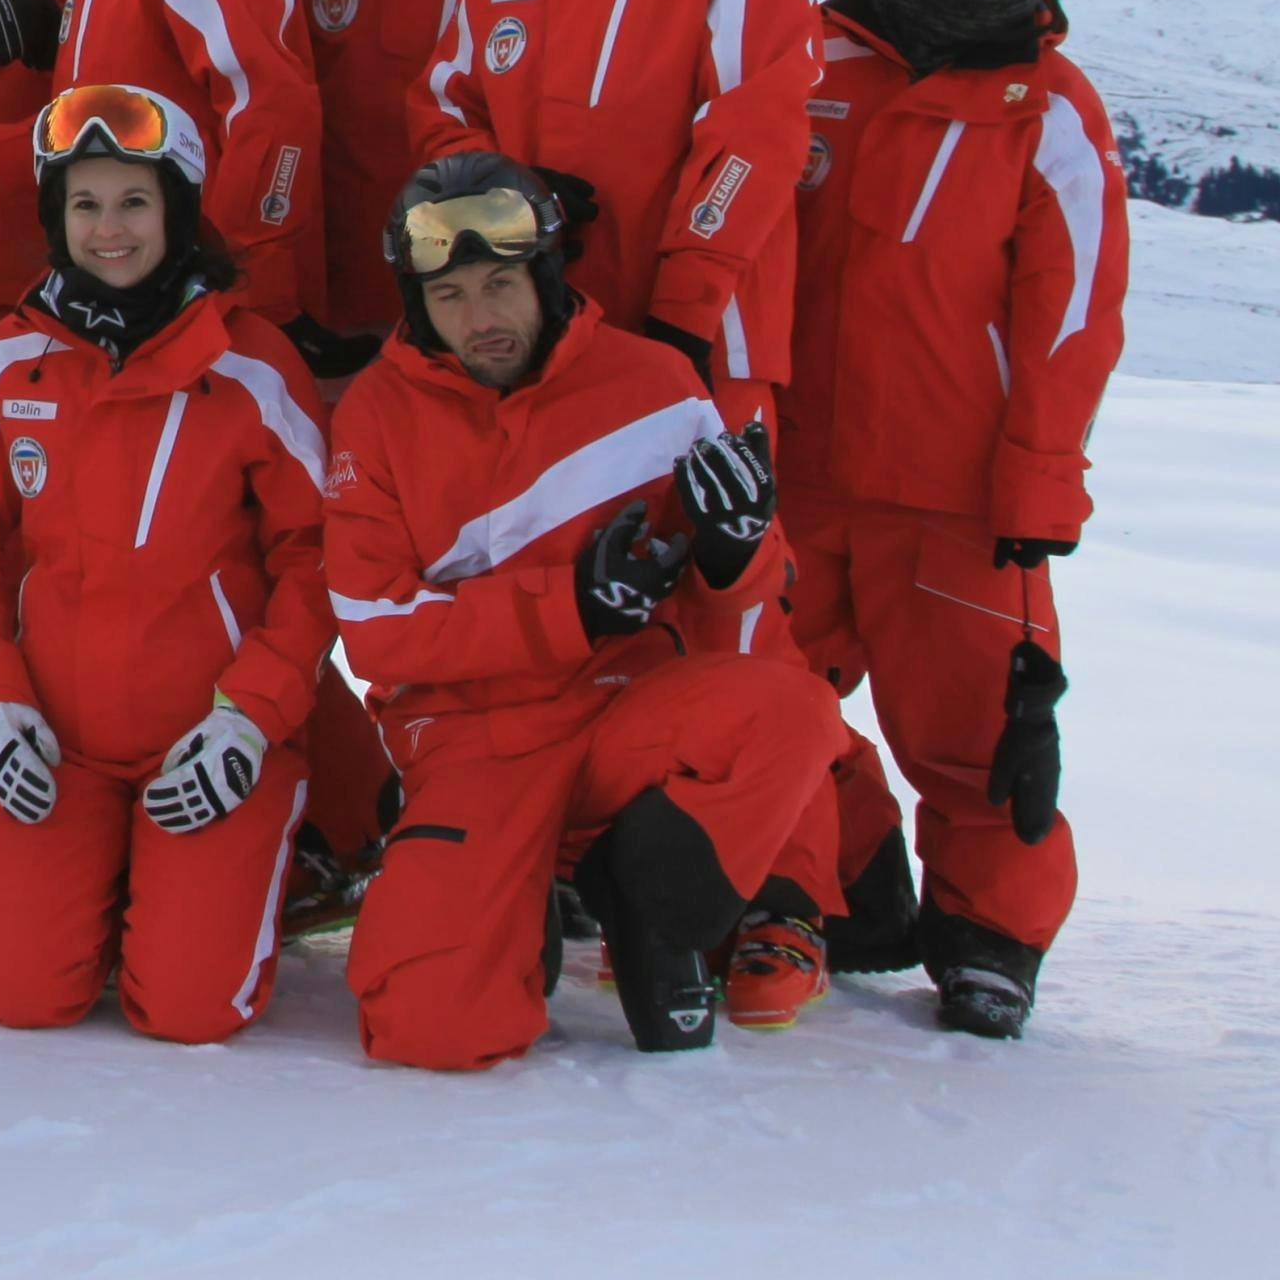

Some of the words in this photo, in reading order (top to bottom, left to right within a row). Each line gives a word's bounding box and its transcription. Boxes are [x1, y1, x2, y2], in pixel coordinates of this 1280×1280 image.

[276, 151, 297, 193] LEAGUE
[714, 162, 745, 207] LEAGUE
[11, 402, 41, 417] Dalin
[739, 445, 769, 485] reusch
